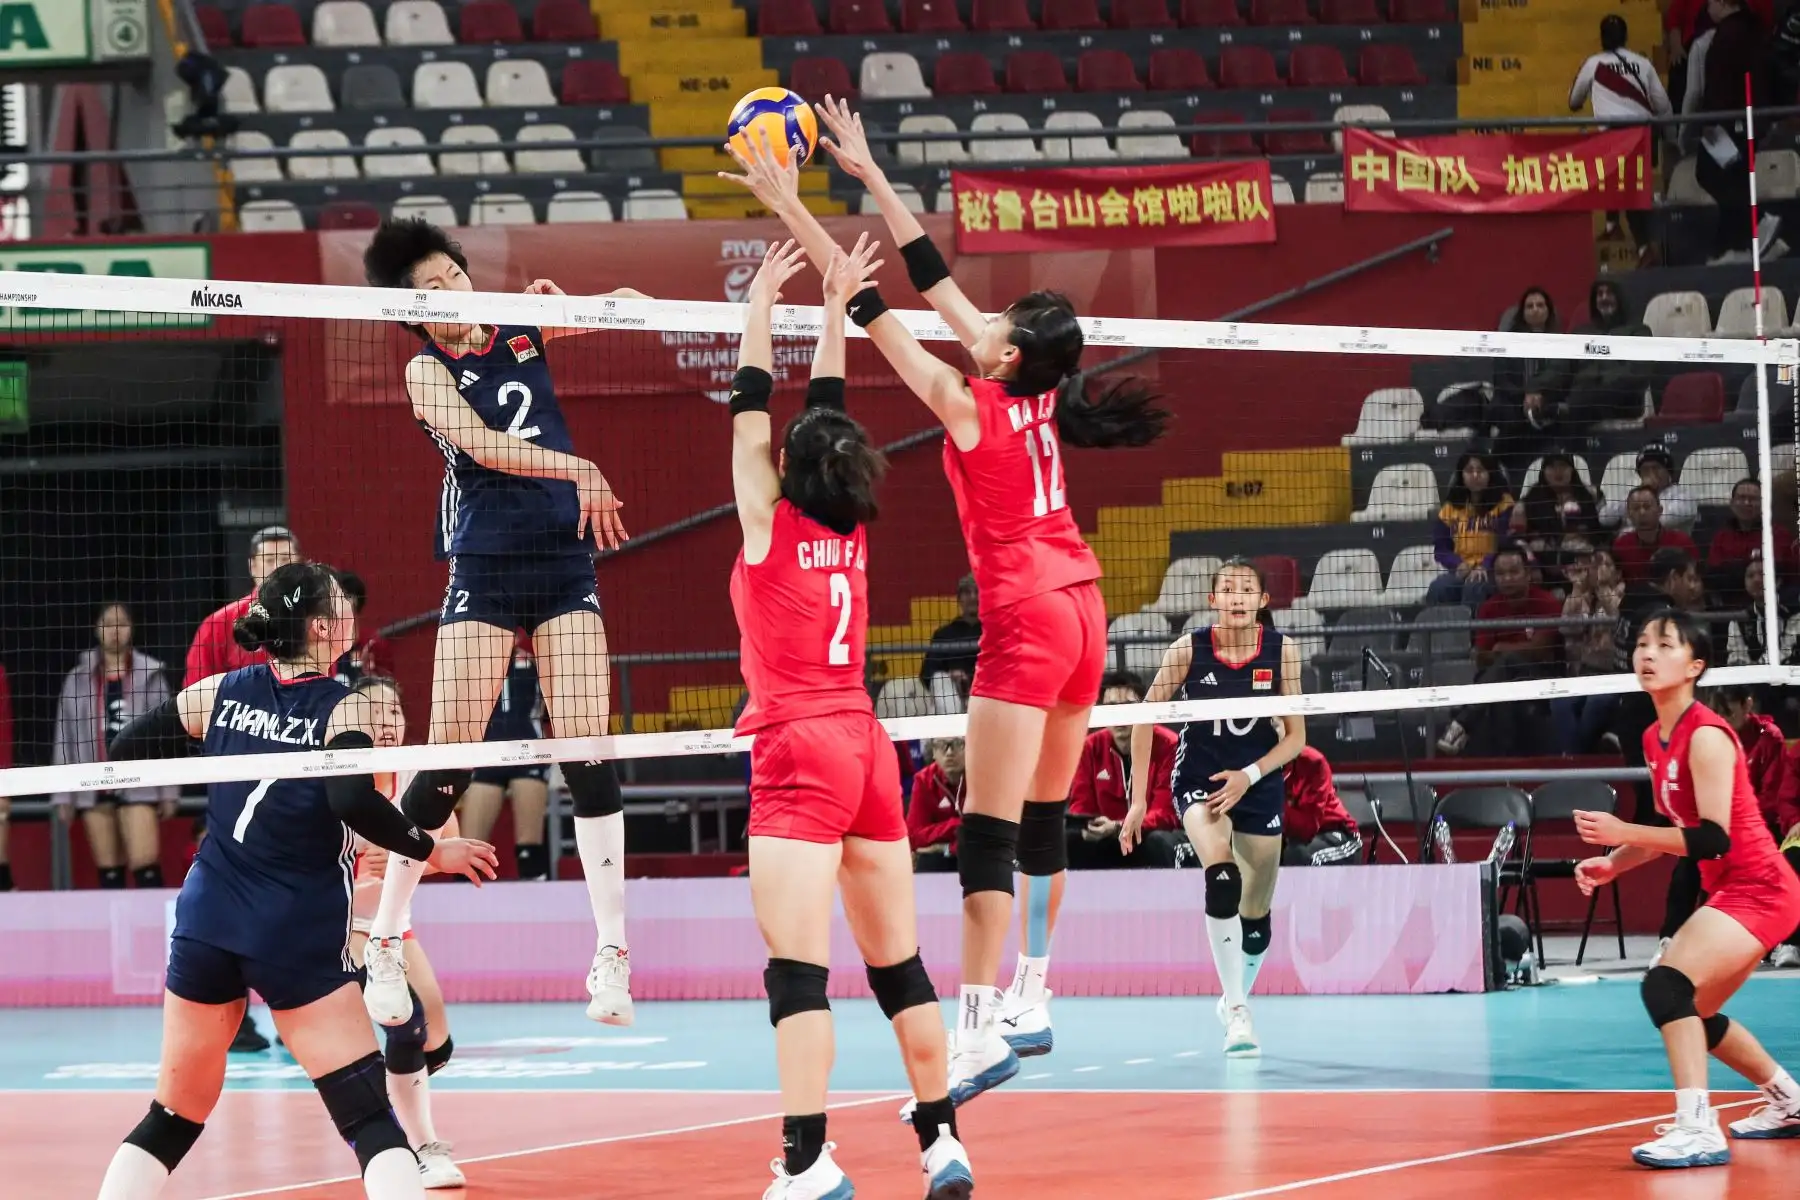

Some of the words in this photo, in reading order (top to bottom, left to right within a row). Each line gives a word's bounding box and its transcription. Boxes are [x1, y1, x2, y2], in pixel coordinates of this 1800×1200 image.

[1351, 148, 1479, 194] 中国队
[958, 180, 1270, 233] 秘鲁台山会馆啦啦队
[721, 240, 766, 258] FIVB
[190, 284, 243, 308] MIKASA
[408, 310, 424, 318] WORLD
[425, 310, 459, 319] CHAMPIONSHIP
[498, 381, 541, 440] 2
[1025, 423, 1066, 517] 12
[797, 538, 841, 569] CHIU
[455, 590, 470, 613] 2
[829, 573, 852, 665] 2
